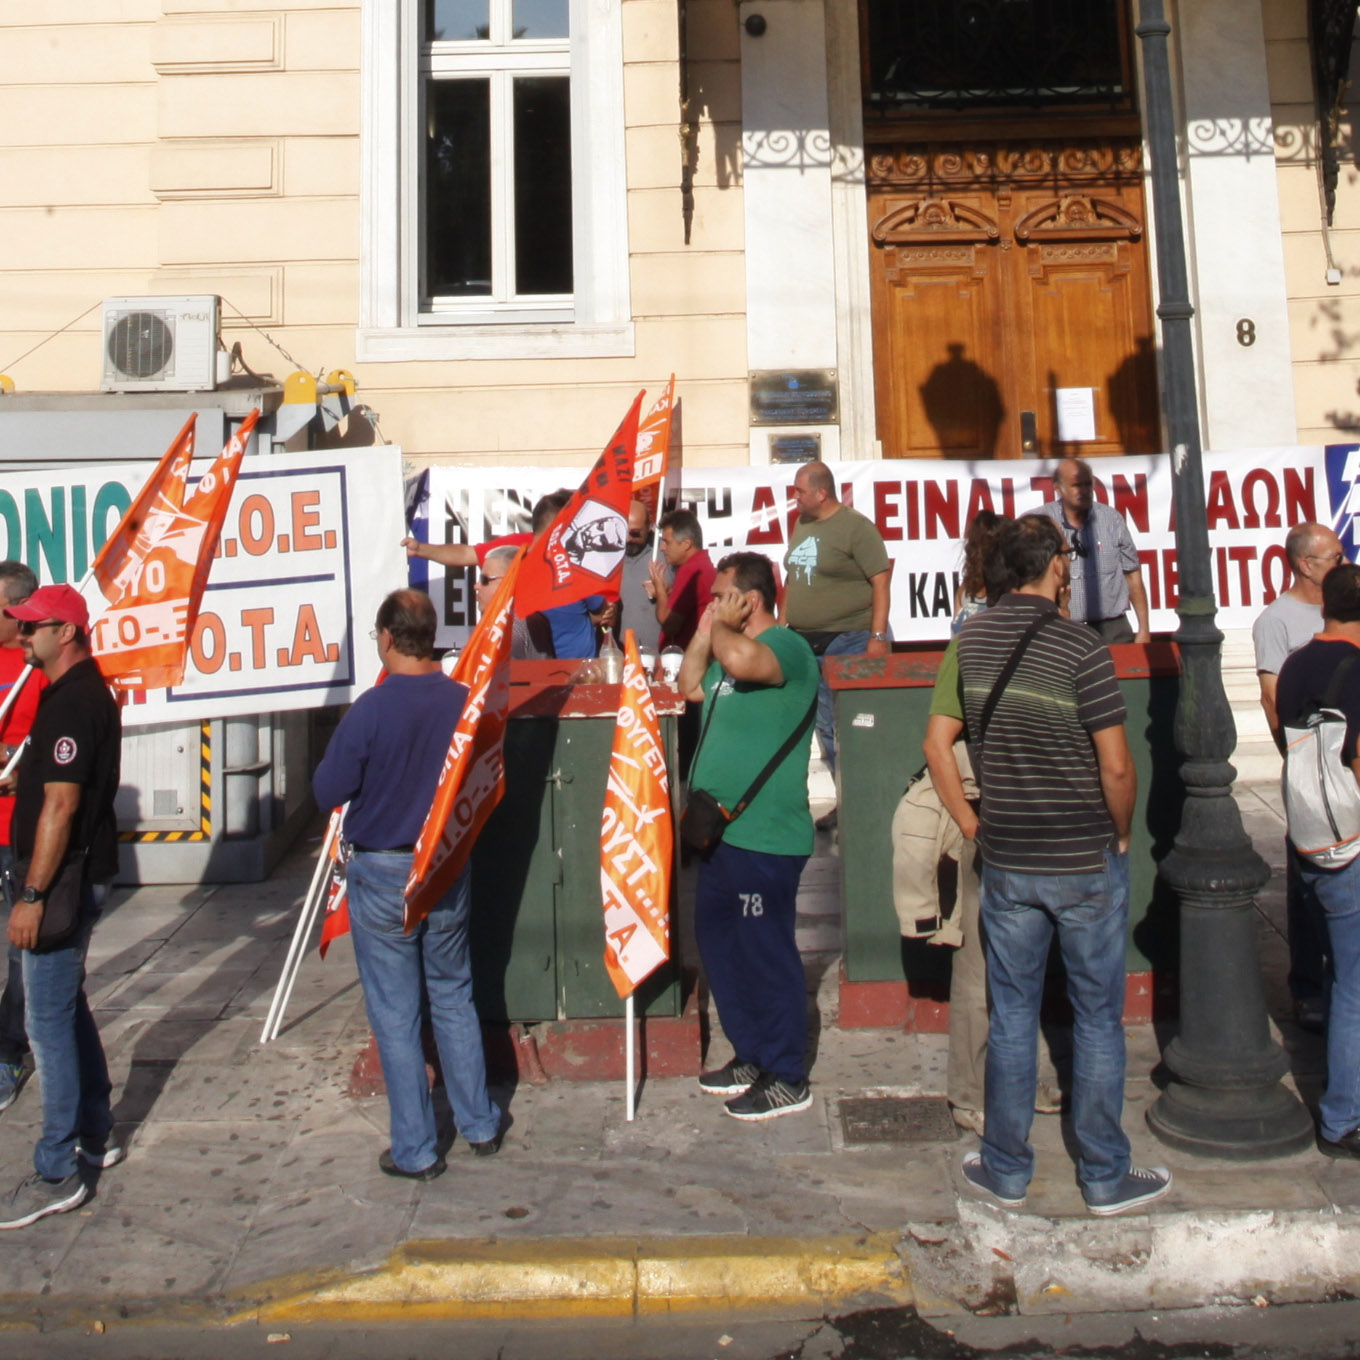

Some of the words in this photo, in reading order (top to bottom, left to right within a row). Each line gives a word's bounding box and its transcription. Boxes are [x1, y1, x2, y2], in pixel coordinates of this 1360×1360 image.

[213, 490, 337, 558] .Ο.Ε.
[874, 477, 1015, 541] ΕΙΝΑΙ
[1168, 466, 1317, 533] ΑΩΝ
[190, 603, 340, 675] Ο.Τ.Α.
[738, 893, 764, 917] 78
